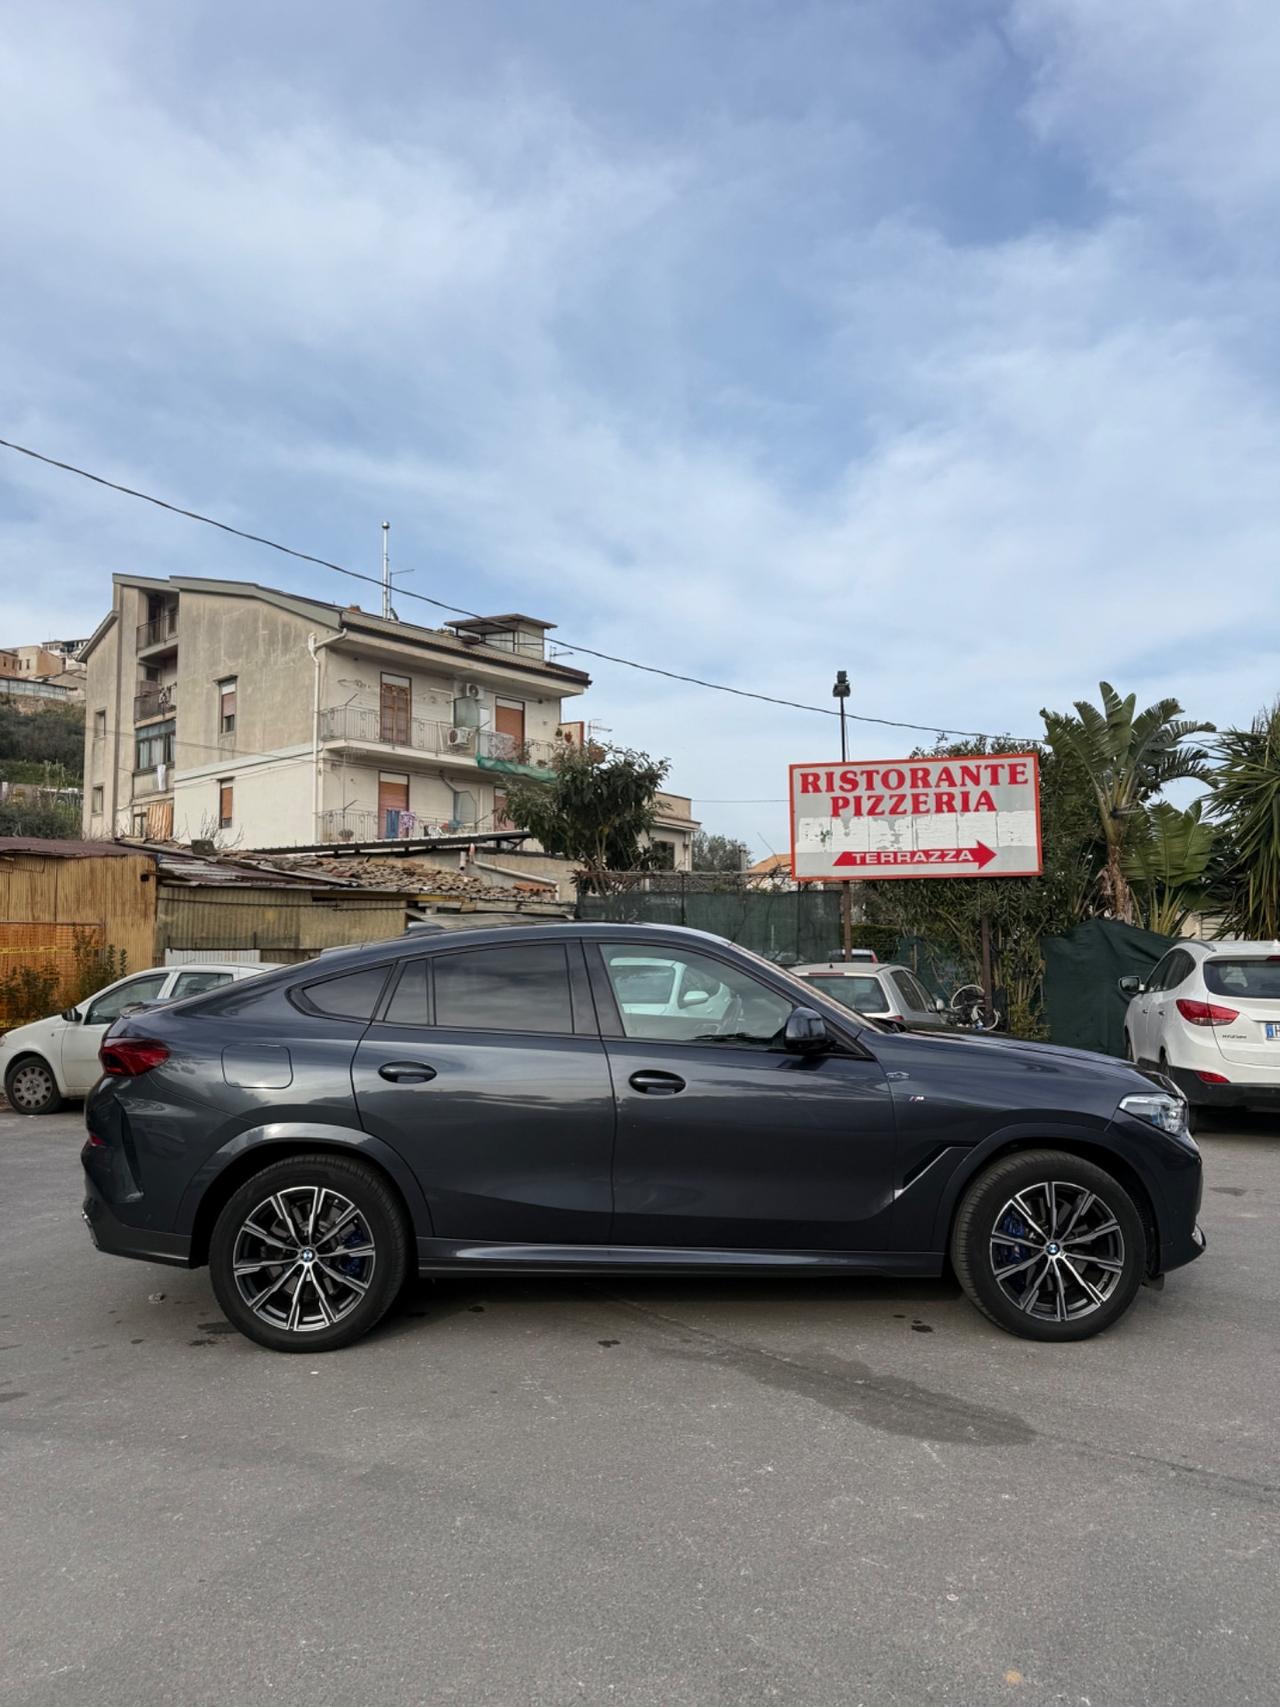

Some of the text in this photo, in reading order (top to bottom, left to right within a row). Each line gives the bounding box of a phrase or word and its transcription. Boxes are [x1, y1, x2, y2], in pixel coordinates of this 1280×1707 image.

[800, 763, 1029, 794] RISTORANTE
[831, 790, 997, 818] PIZZERIA
[852, 850, 974, 864] TERRAZZA
